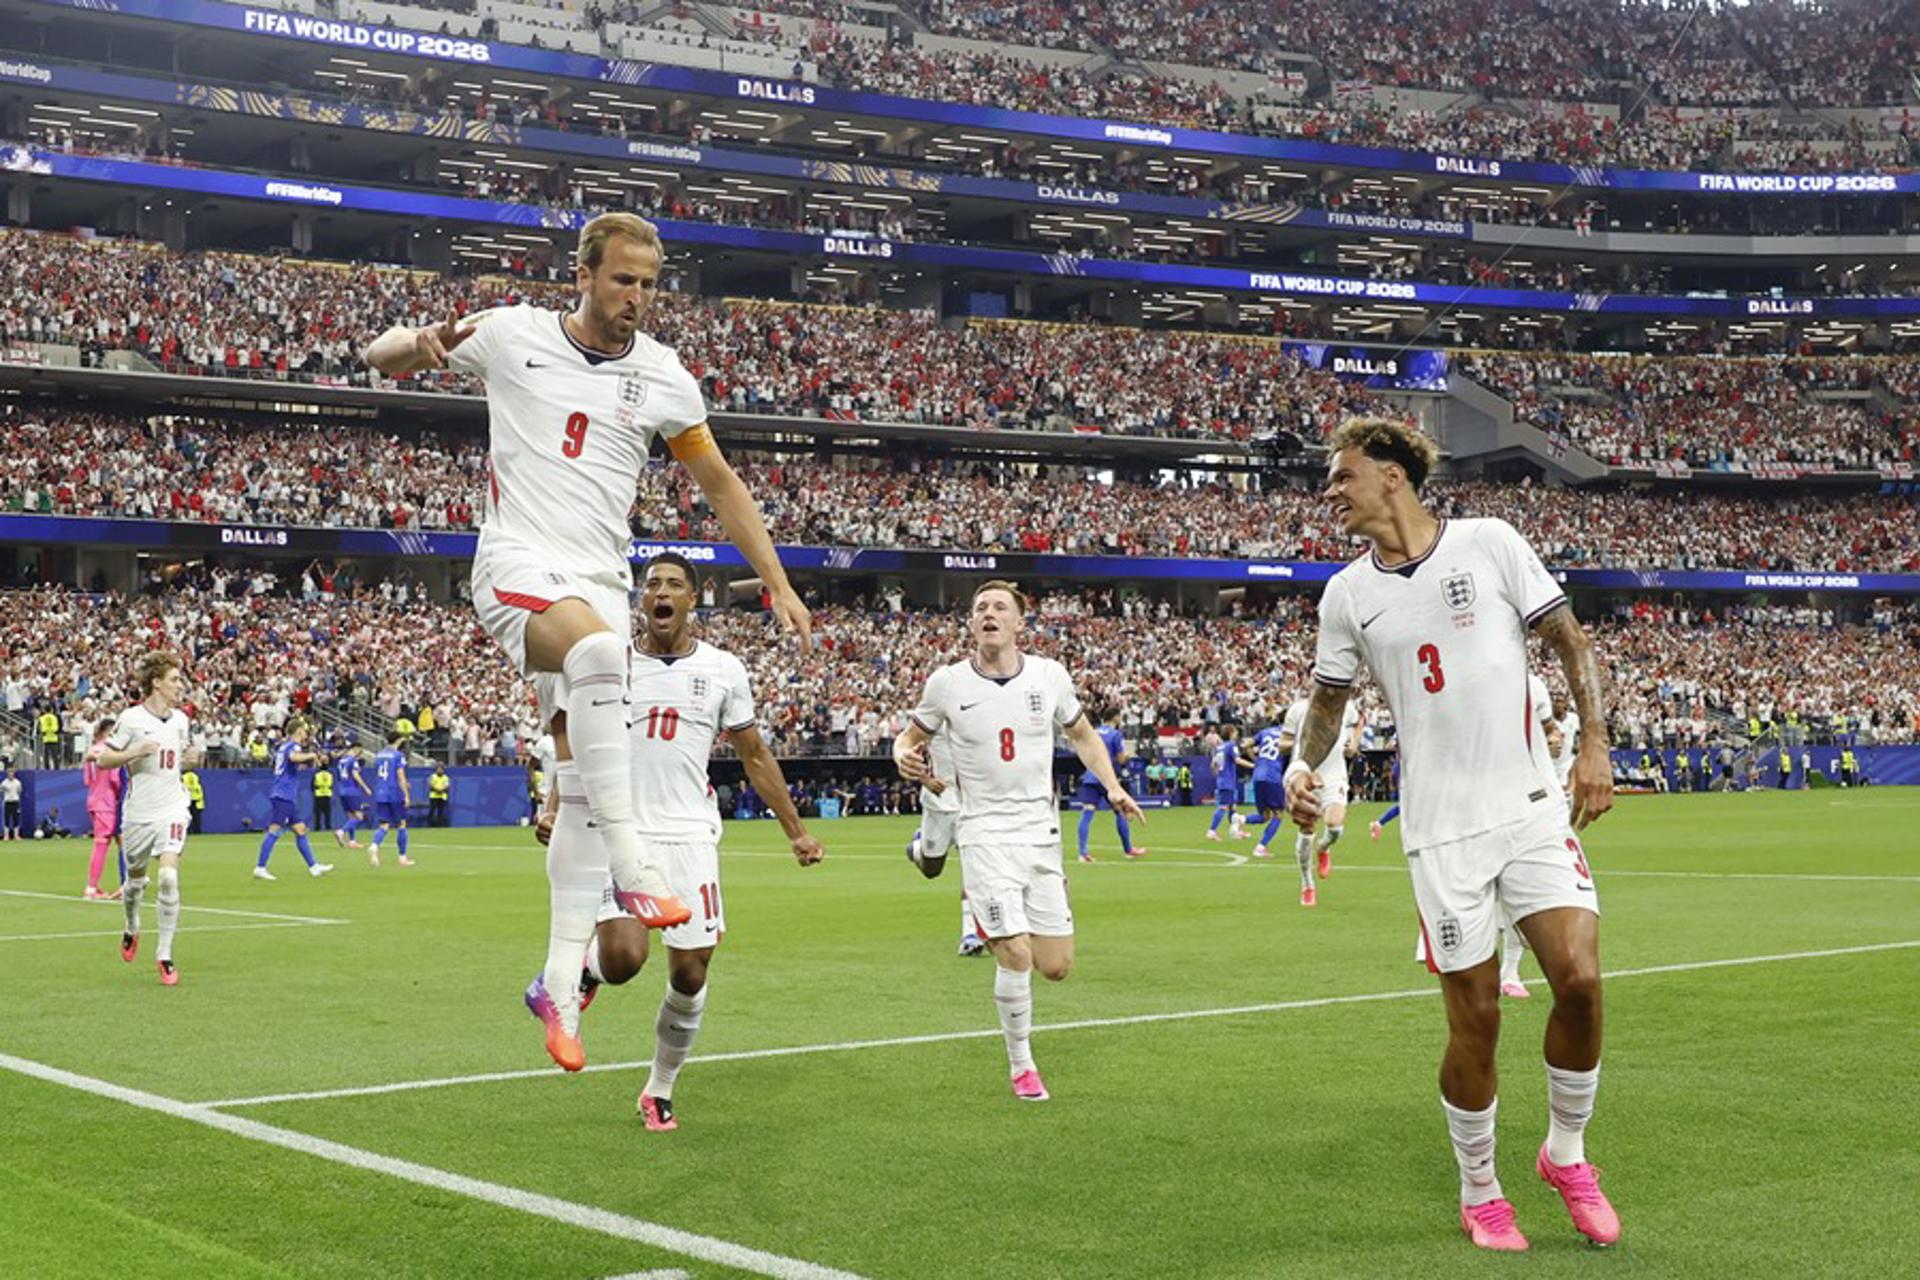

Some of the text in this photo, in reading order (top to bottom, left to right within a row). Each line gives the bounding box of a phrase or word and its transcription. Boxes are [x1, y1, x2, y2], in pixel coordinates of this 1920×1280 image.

[244, 10, 490, 61] FIFA WORLD CUP 2026
[737, 79, 815, 104] DALLAS
[1436, 156, 1501, 176] DALLAS
[1699, 174, 1897, 191] FIFA WORLD CUP 2026
[1037, 186, 1120, 204] DALLAS
[1327, 212, 1465, 234] FIFA WORLD CUP 2026
[824, 238, 892, 258] DALLAS
[1250, 273, 1417, 299] FIFA WORLD CUP 2026
[1748, 300, 1814, 314] DALLAS
[1333, 358, 1397, 375] DALLAS
[562, 411, 590, 459] 9
[221, 528, 288, 545] DALLAS
[944, 555, 996, 569] DALLAS
[1767, 575, 1803, 587] WORLD
[1804, 576, 1824, 587] CUP
[1417, 643, 1446, 694] 3
[646, 705, 680, 741] 10
[999, 726, 1016, 762] 8
[160, 748, 176, 770] 18
[377, 760, 389, 782] 4
